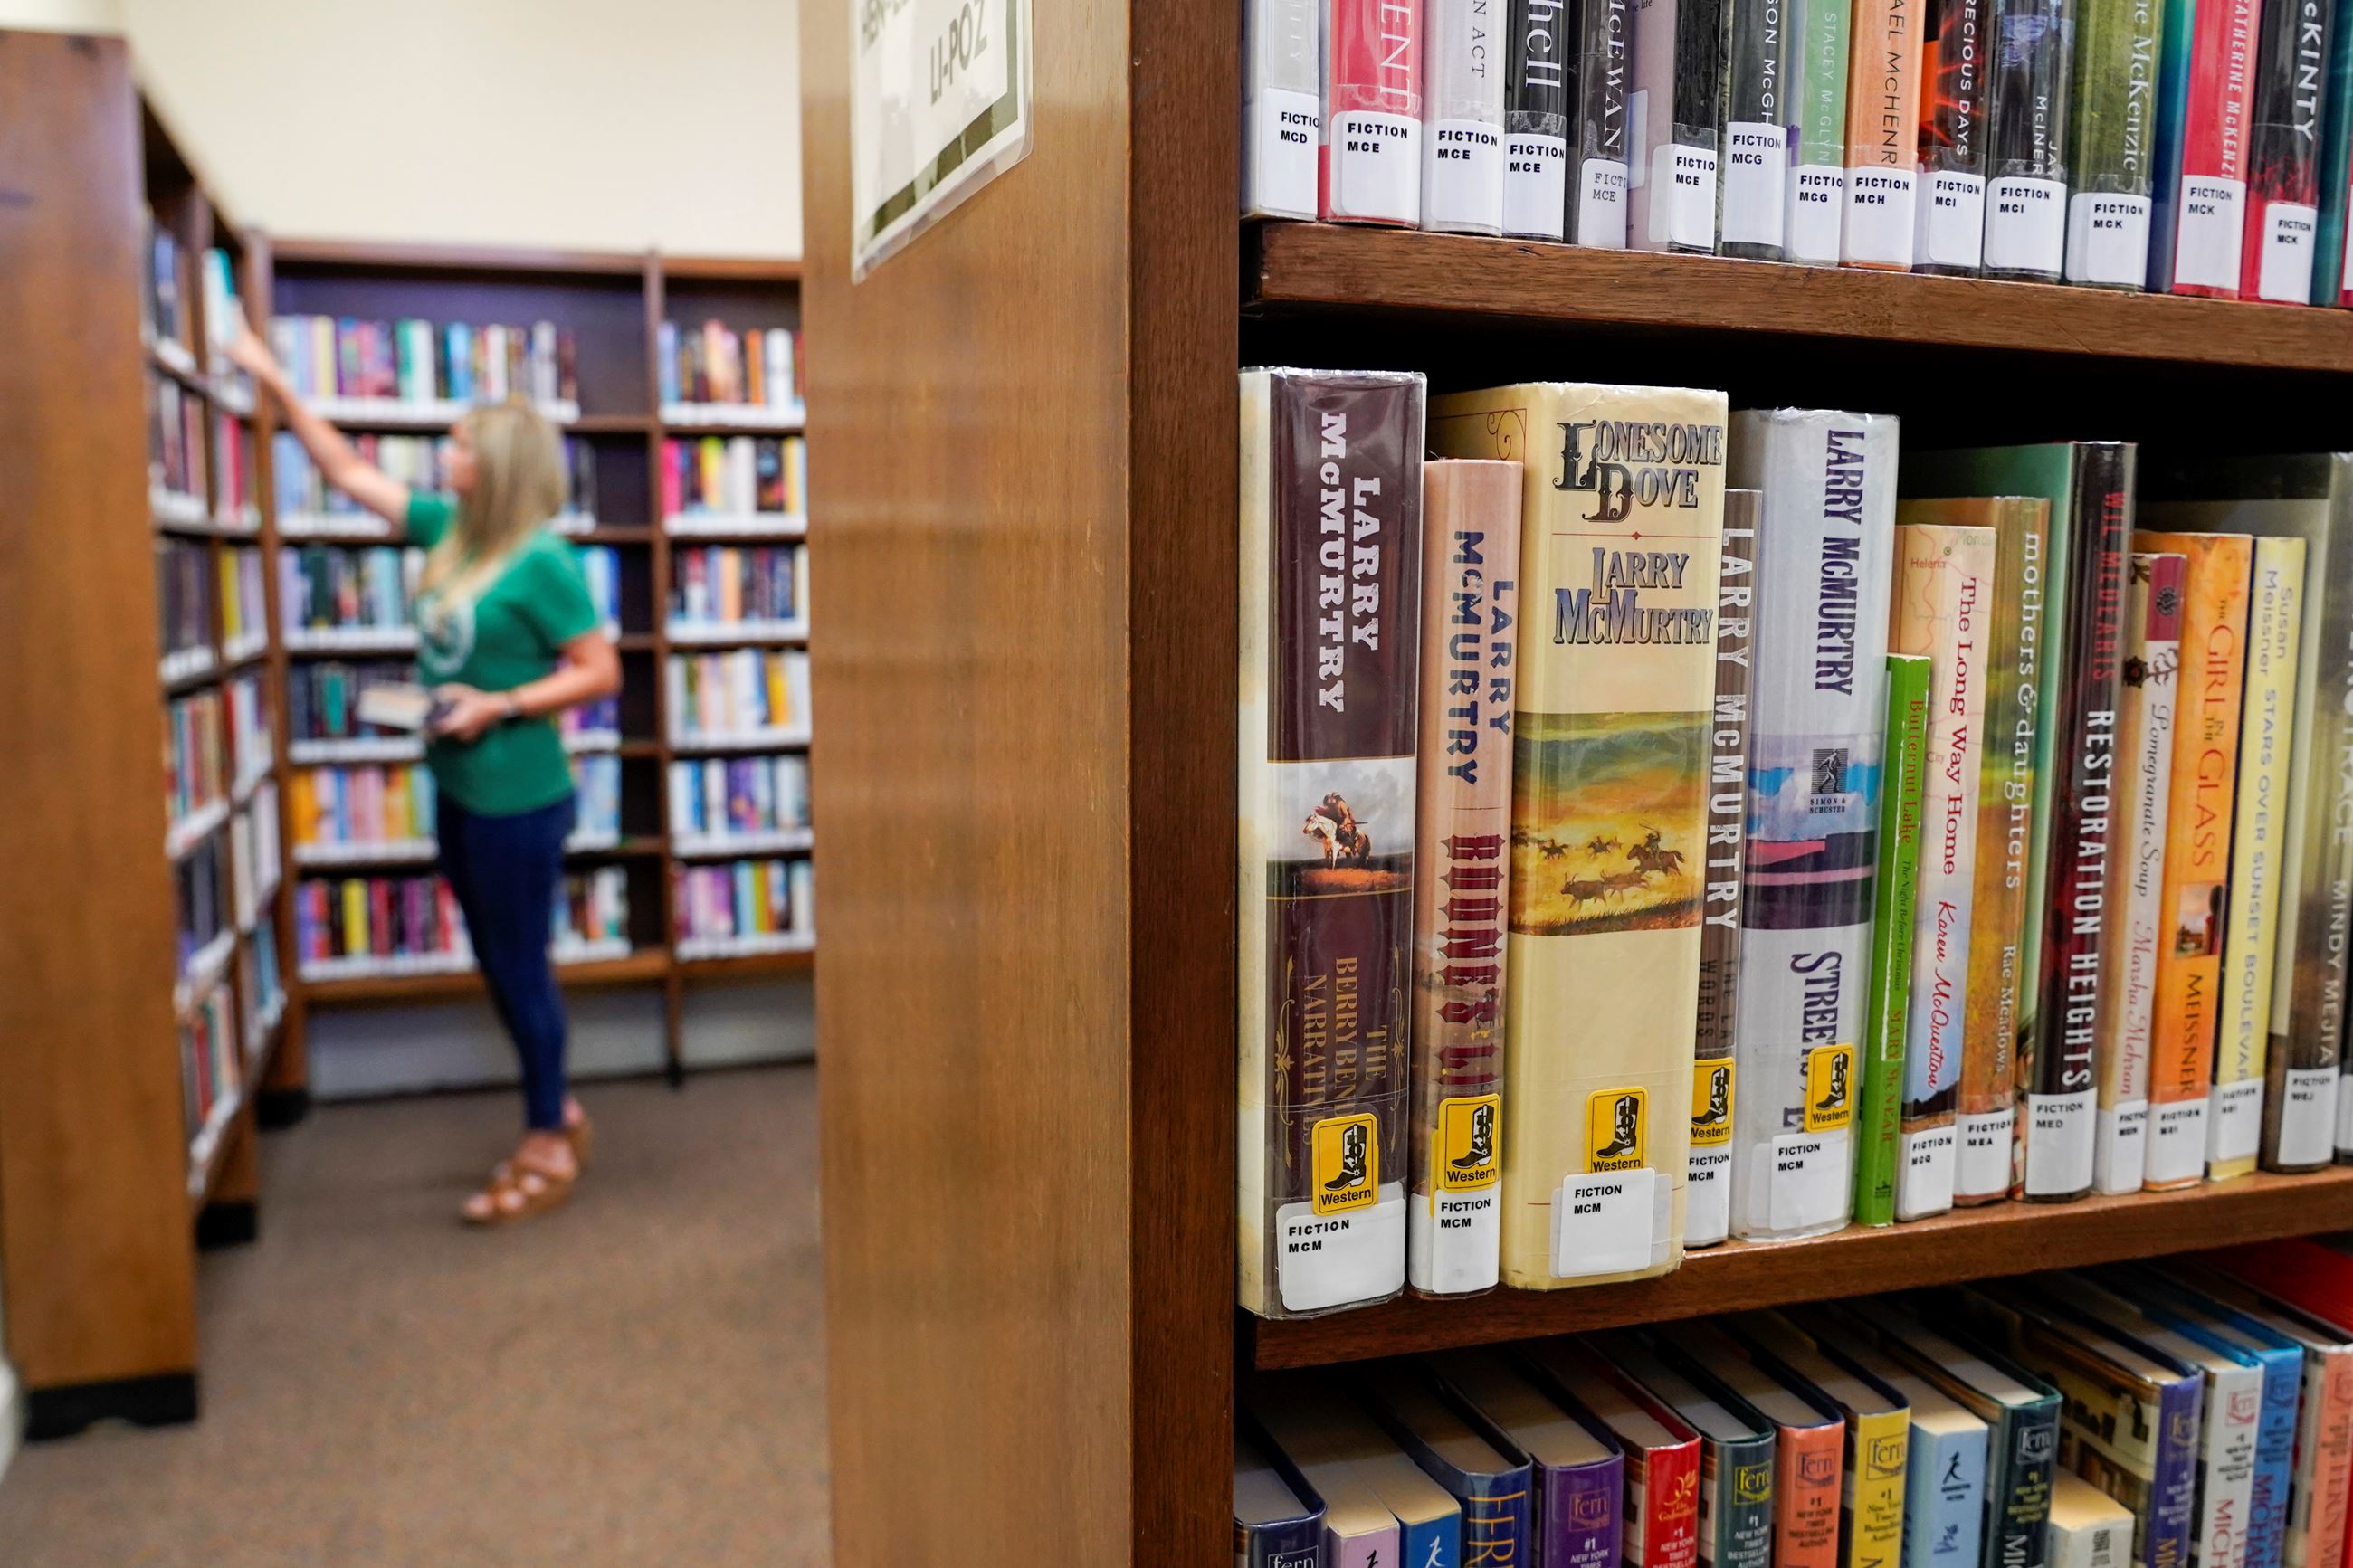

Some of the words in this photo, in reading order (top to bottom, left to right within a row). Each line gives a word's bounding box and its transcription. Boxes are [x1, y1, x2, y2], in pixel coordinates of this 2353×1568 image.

[1471, 26, 1486, 78] ACT
[1821, 13, 1837, 80] STACEY
[2227, 0, 2250, 92] ATHERINE
[2123, 36, 2152, 171] McKenzie
[1281, 130, 1308, 144] MCD
[1348, 122, 1408, 138] FICTION
[1438, 130, 1498, 147] FICTION
[1956, 100, 1971, 156] DAYS
[1348, 141, 1380, 153] MCE
[1510, 145, 1565, 158] FICTION
[1733, 135, 1781, 149] FICTION
[1437, 149, 1471, 160] MCE
[1676, 157, 1715, 171] FICTIO
[1732, 154, 1763, 166] MCG
[1510, 163, 1541, 173] MCE
[1676, 174, 1700, 186] MCE
[1855, 177, 1910, 191] FICTION
[1936, 180, 1980, 195] FICTION
[1593, 190, 1616, 202] MCE
[1799, 192, 1828, 203] MCG
[1855, 195, 1885, 204] MCH
[1935, 196, 1957, 207] MCI
[2001, 187, 2050, 200] FICTION
[2189, 187, 2232, 201] FICTION
[2000, 204, 2024, 213] MCI
[2094, 204, 2143, 215] FICTION
[2188, 204, 2215, 215] MCK
[2093, 220, 2122, 229] MCK
[2278, 219, 2310, 232] FICTION
[2277, 235, 2298, 244] MCK
[1552, 419, 1724, 491] LONESOME
[1824, 430, 1865, 525] LARRY
[1582, 462, 1700, 523] DOVE
[1319, 413, 1347, 712] McMURTRY
[1352, 477, 1381, 651] LARRY
[1590, 547, 1689, 604] LARRY
[1717, 527, 1756, 668] LARRY
[1958, 577, 1976, 632] The
[2017, 532, 2042, 676] mothers
[2259, 569, 2279, 676] Meissner
[2276, 588, 2292, 659] Susan
[1446, 530, 1484, 785] McMURTRY
[1488, 580, 1514, 736] LARRY
[1949, 641, 1973, 716] Long
[2203, 624, 2234, 716] GIRL
[2016, 683, 2038, 716] &
[2259, 689, 2278, 766] STARS
[1904, 700, 1923, 794] Butternut
[1946, 725, 1967, 784] Way
[2141, 704, 2171, 835] Pomegranate
[1810, 797, 1838, 806] SIMON
[1810, 805, 1845, 813] SCHUSTER
[2005, 718, 2035, 889] daughters
[2194, 748, 2226, 867] GLASS
[2254, 774, 2272, 842] OVER
[1900, 800, 1918, 844] Lake
[2072, 709, 2115, 935] RESTORATION
[1943, 794, 1963, 875] Home
[2134, 841, 2161, 898] Soup
[2245, 851, 2267, 943] SUNSET
[1934, 900, 1957, 963] Karen
[2327, 879, 2348, 965] MINDY
[2002, 945, 2016, 979] Rae
[2128, 921, 2153, 1010] Marsha
[1996, 987, 2014, 1073] Meadows
[2062, 952, 2100, 1087] HEIGHTS
[2319, 978, 2339, 1065] MEJIA
[2180, 973, 2204, 1095] MEISSNER
[1366, 1025, 1387, 1080] THE
[1812, 1109, 1850, 1123] Western
[2037, 1102, 2083, 1114] FICTION
[2036, 1119, 2063, 1128] MED
[1778, 1144, 1821, 1156] FICTION
[1911, 1136, 1952, 1151] FICTION
[1594, 1159, 1641, 1173] Western
[1689, 1153, 1729, 1165] FICTION
[1778, 1161, 1803, 1171] MCM
[1447, 1167, 1495, 1183] Western
[1688, 1171, 1714, 1181] MCM
[1321, 1189, 1371, 1205] Western
[1575, 1185, 1622, 1198] FICTION
[1441, 1199, 1491, 1212] FICTION
[1574, 1203, 1601, 1214] MCM
[1288, 1220, 1350, 1236] FICTION
[1441, 1218, 1472, 1228] MCM
[1288, 1240, 1322, 1253] MCM
[1872, 1440, 1905, 1463] fern
[1801, 1454, 1833, 1478] fern
[1739, 1468, 1769, 1490] fern
[1574, 1495, 1607, 1517] fern
[1584, 1537, 1596, 1551] #1
